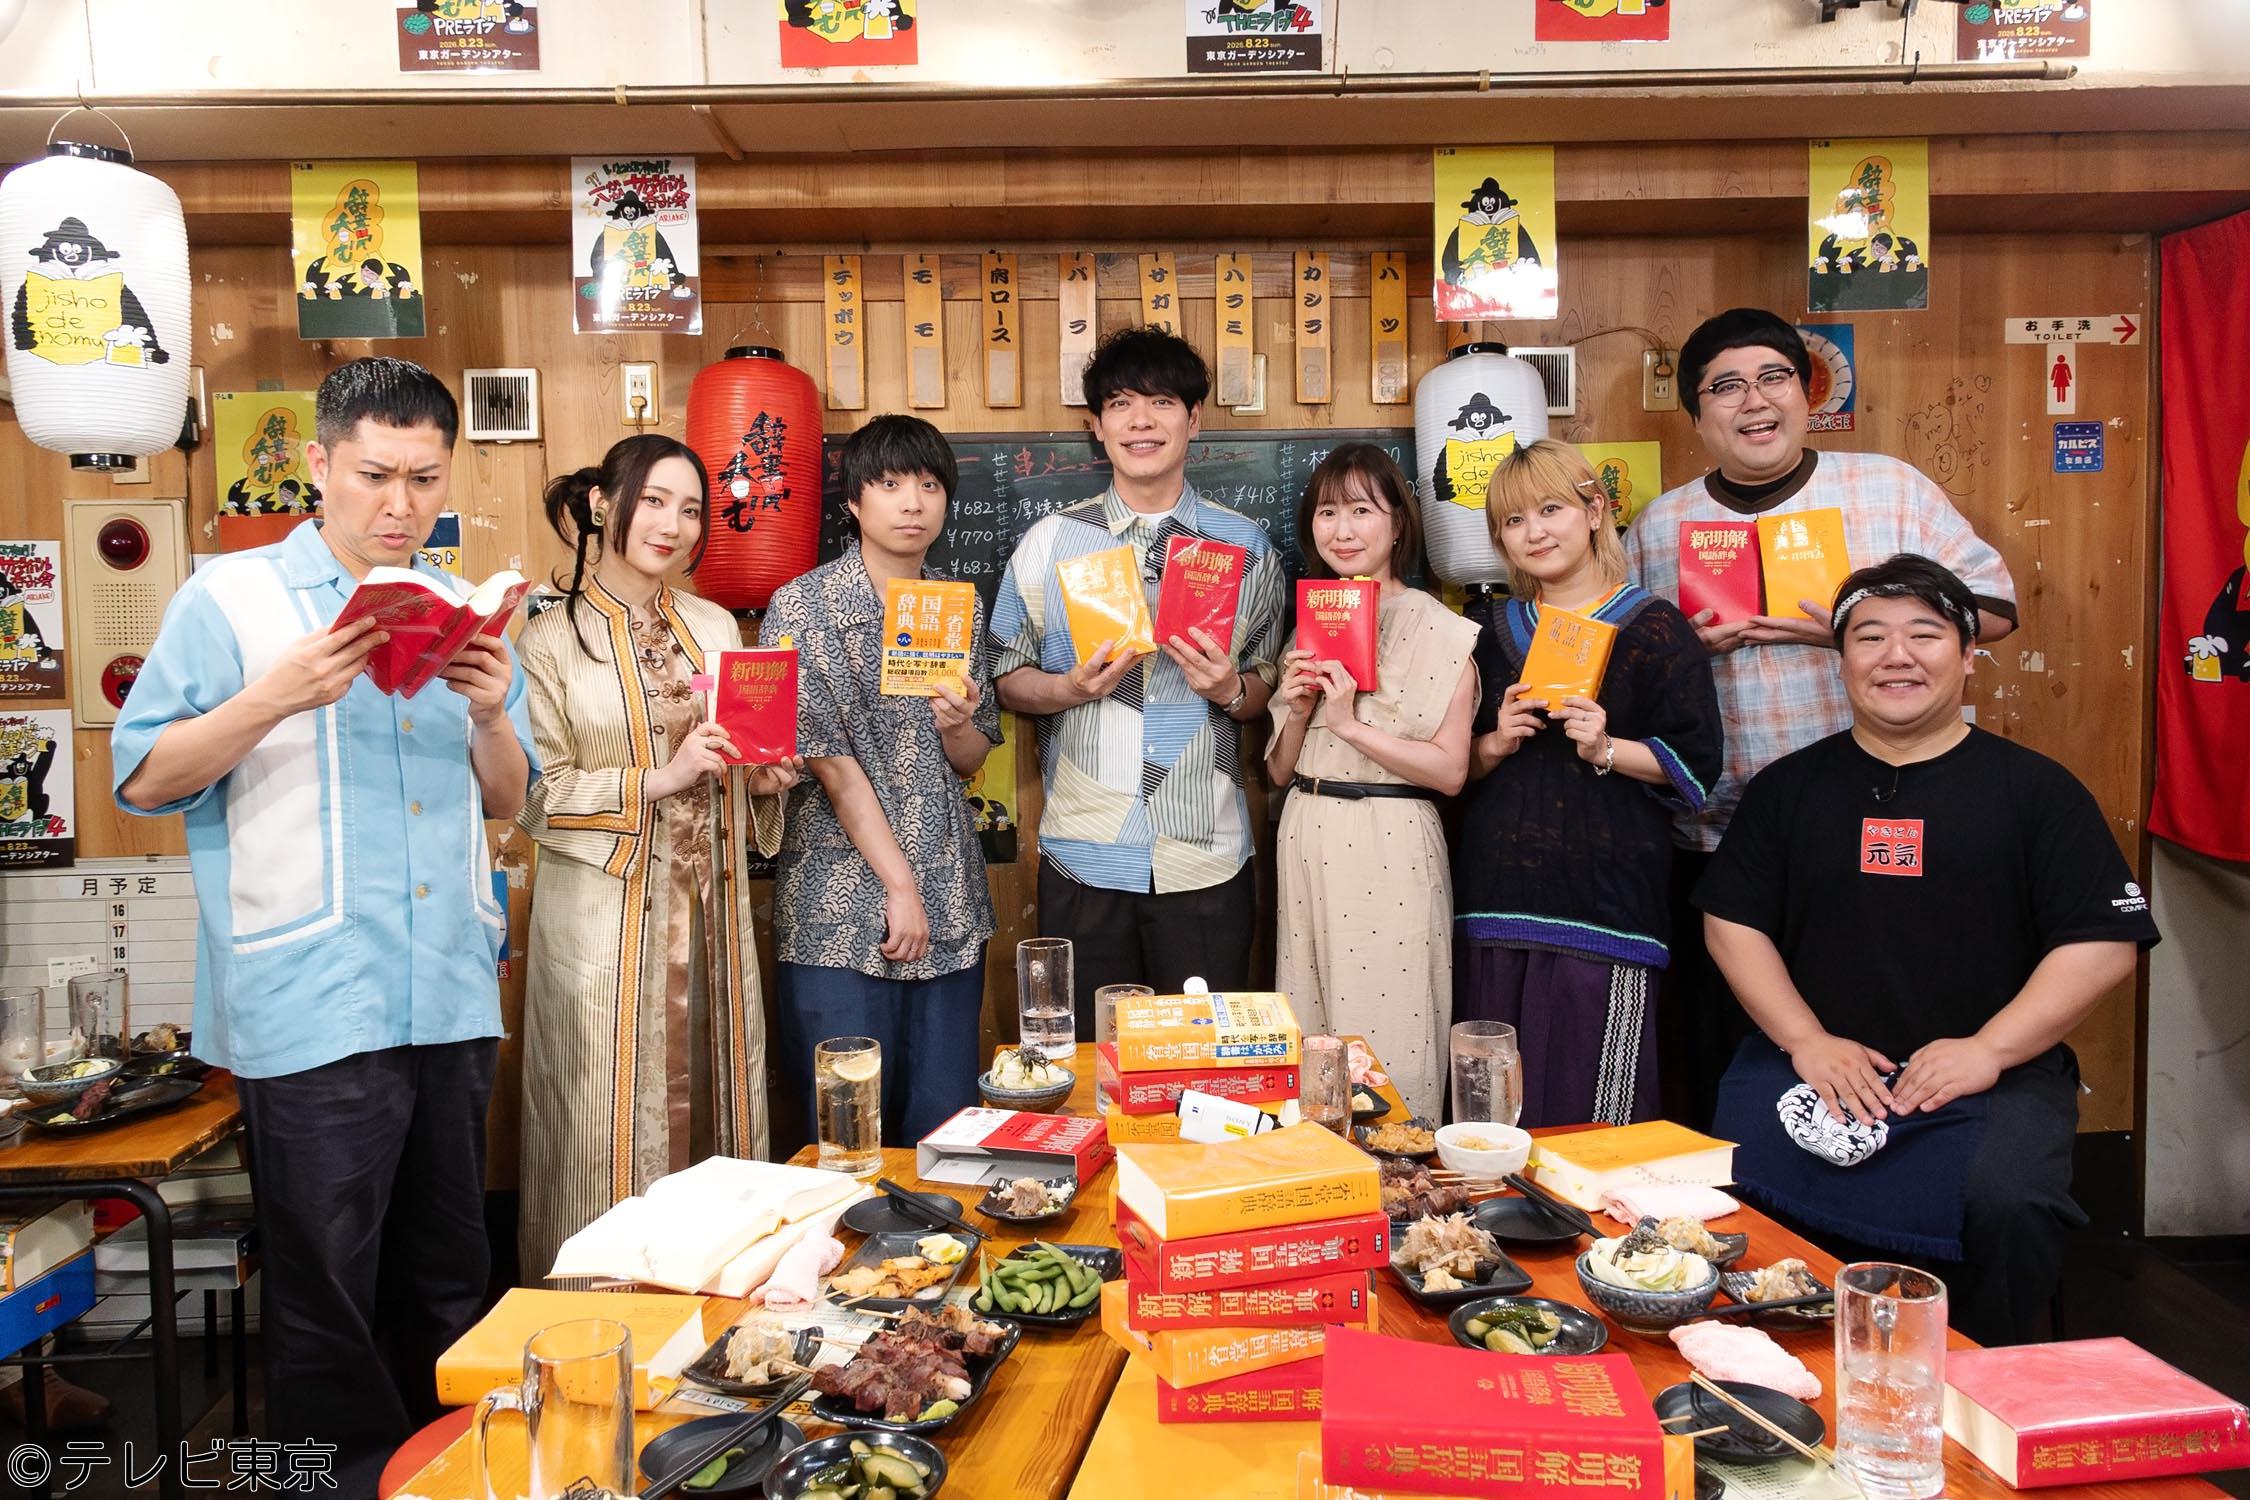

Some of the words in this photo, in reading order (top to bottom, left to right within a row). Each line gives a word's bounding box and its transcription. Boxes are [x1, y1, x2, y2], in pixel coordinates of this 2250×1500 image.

[2016, 26, 2040, 36] 8.23
[458, 38, 483, 48] 8.23
[1245, 38, 1270, 49] 8.23
[418, 49, 522, 60] 東京ガーデンシアター
[1206, 48, 1306, 61] 東京ガーデンシアター
[36, 289, 109, 313] jisho
[832, 269, 855, 346] テッポウ
[912, 269, 935, 338] モモ
[1067, 266, 1090, 335] バラ
[1224, 268, 1246, 335] ハラミ
[1303, 266, 1323, 335] カシラ
[1378, 267, 1401, 333] ハツ
[46, 311, 86, 329] de
[592, 313, 685, 323] 東ガーデンシアター
[2025, 319, 2091, 332] お手洗
[40, 330, 104, 347] nomu
[2035, 333, 2082, 341] TOILET
[2057, 438, 2099, 450] カルピス
[1454, 448, 1506, 470] jisho
[1233, 484, 1278, 508] ¥418
[952, 499, 994, 520] ¥682
[946, 530, 994, 548] ¥770
[1689, 529, 1749, 550] 新明解
[1178, 549, 1234, 574] 新明解
[1698, 550, 1738, 561] 国語辞典
[950, 558, 994, 577] ¥682
[1183, 570, 1220, 585] 国語辞典
[1306, 588, 1361, 609] 新明解
[897, 593, 917, 631] 辞典
[920, 595, 942, 633] 国語
[1315, 610, 1352, 621] 国語辞典
[944, 596, 965, 650] 三省堂
[730, 661, 789, 682] 新明解
[1867, 825, 1918, 838] やきとん
[1866, 842, 1918, 867] 元気
[112, 904, 126, 917] 16
[112, 925, 126, 938] 17
[113, 946, 126, 959] 18
[1169, 1235, 1345, 1281] 新明解国語辞典
[1137, 1287, 1319, 1319] 新明解国語辞典
[1552, 1362, 1628, 1418] 新明解
[2032, 1430, 2208, 1471] 新明解国語辞典
[1385, 1441, 1643, 1491] 新明解国語辞典
